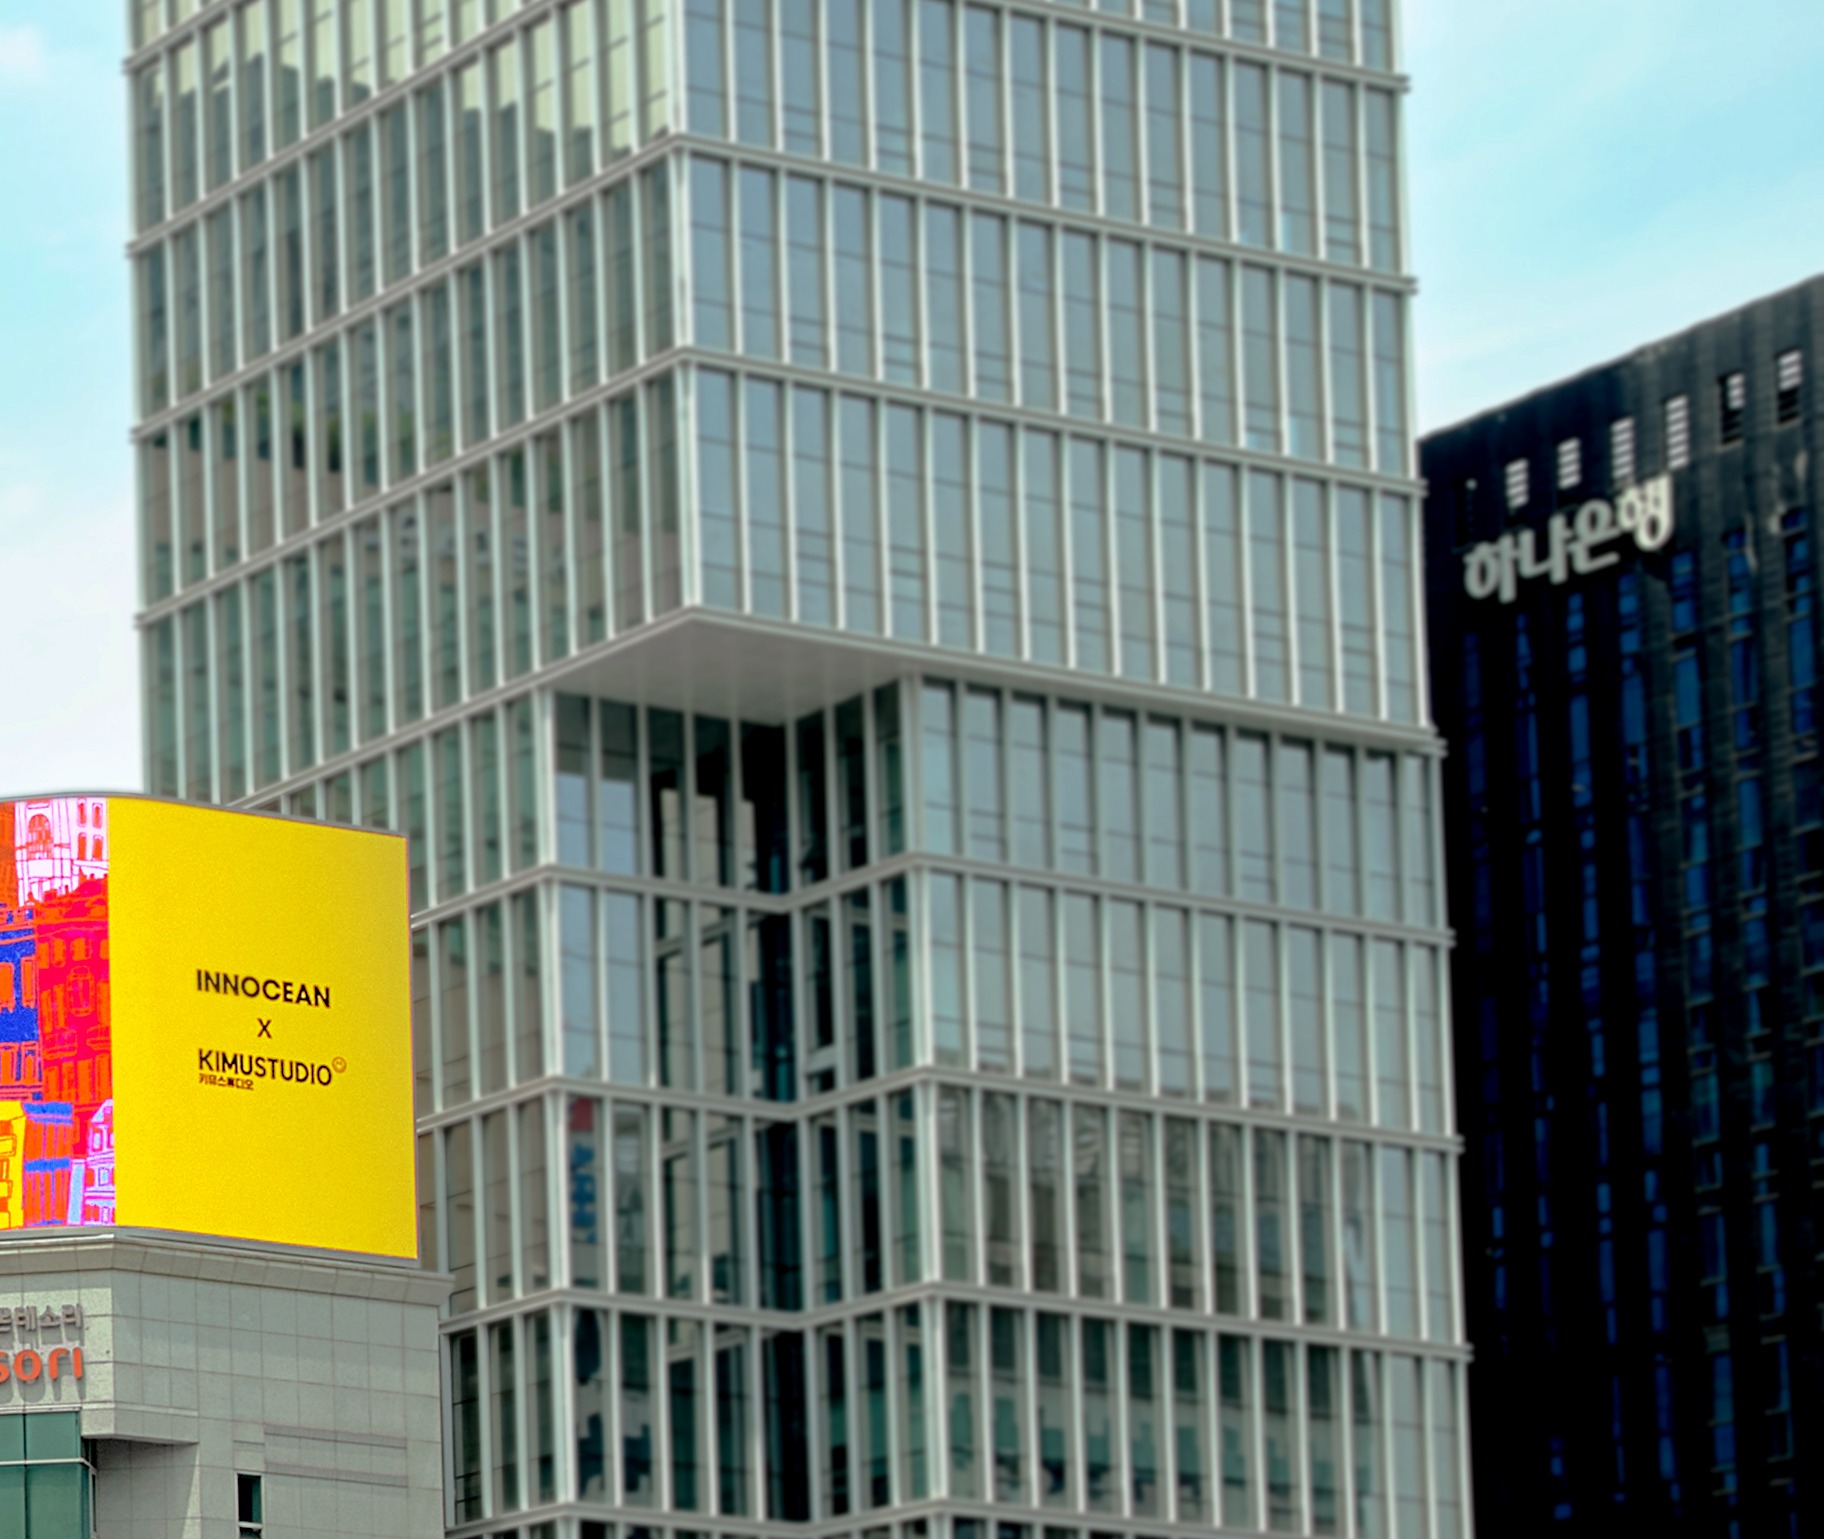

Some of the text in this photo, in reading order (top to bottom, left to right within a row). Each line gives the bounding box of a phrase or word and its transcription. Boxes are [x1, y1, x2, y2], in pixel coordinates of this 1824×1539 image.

[1463, 473, 1674, 604] 하나은행
[196, 968, 331, 1009] INNOCEAN
[256, 1017, 272, 1039] X
[198, 1048, 332, 1086] KIMUSTUDIO
